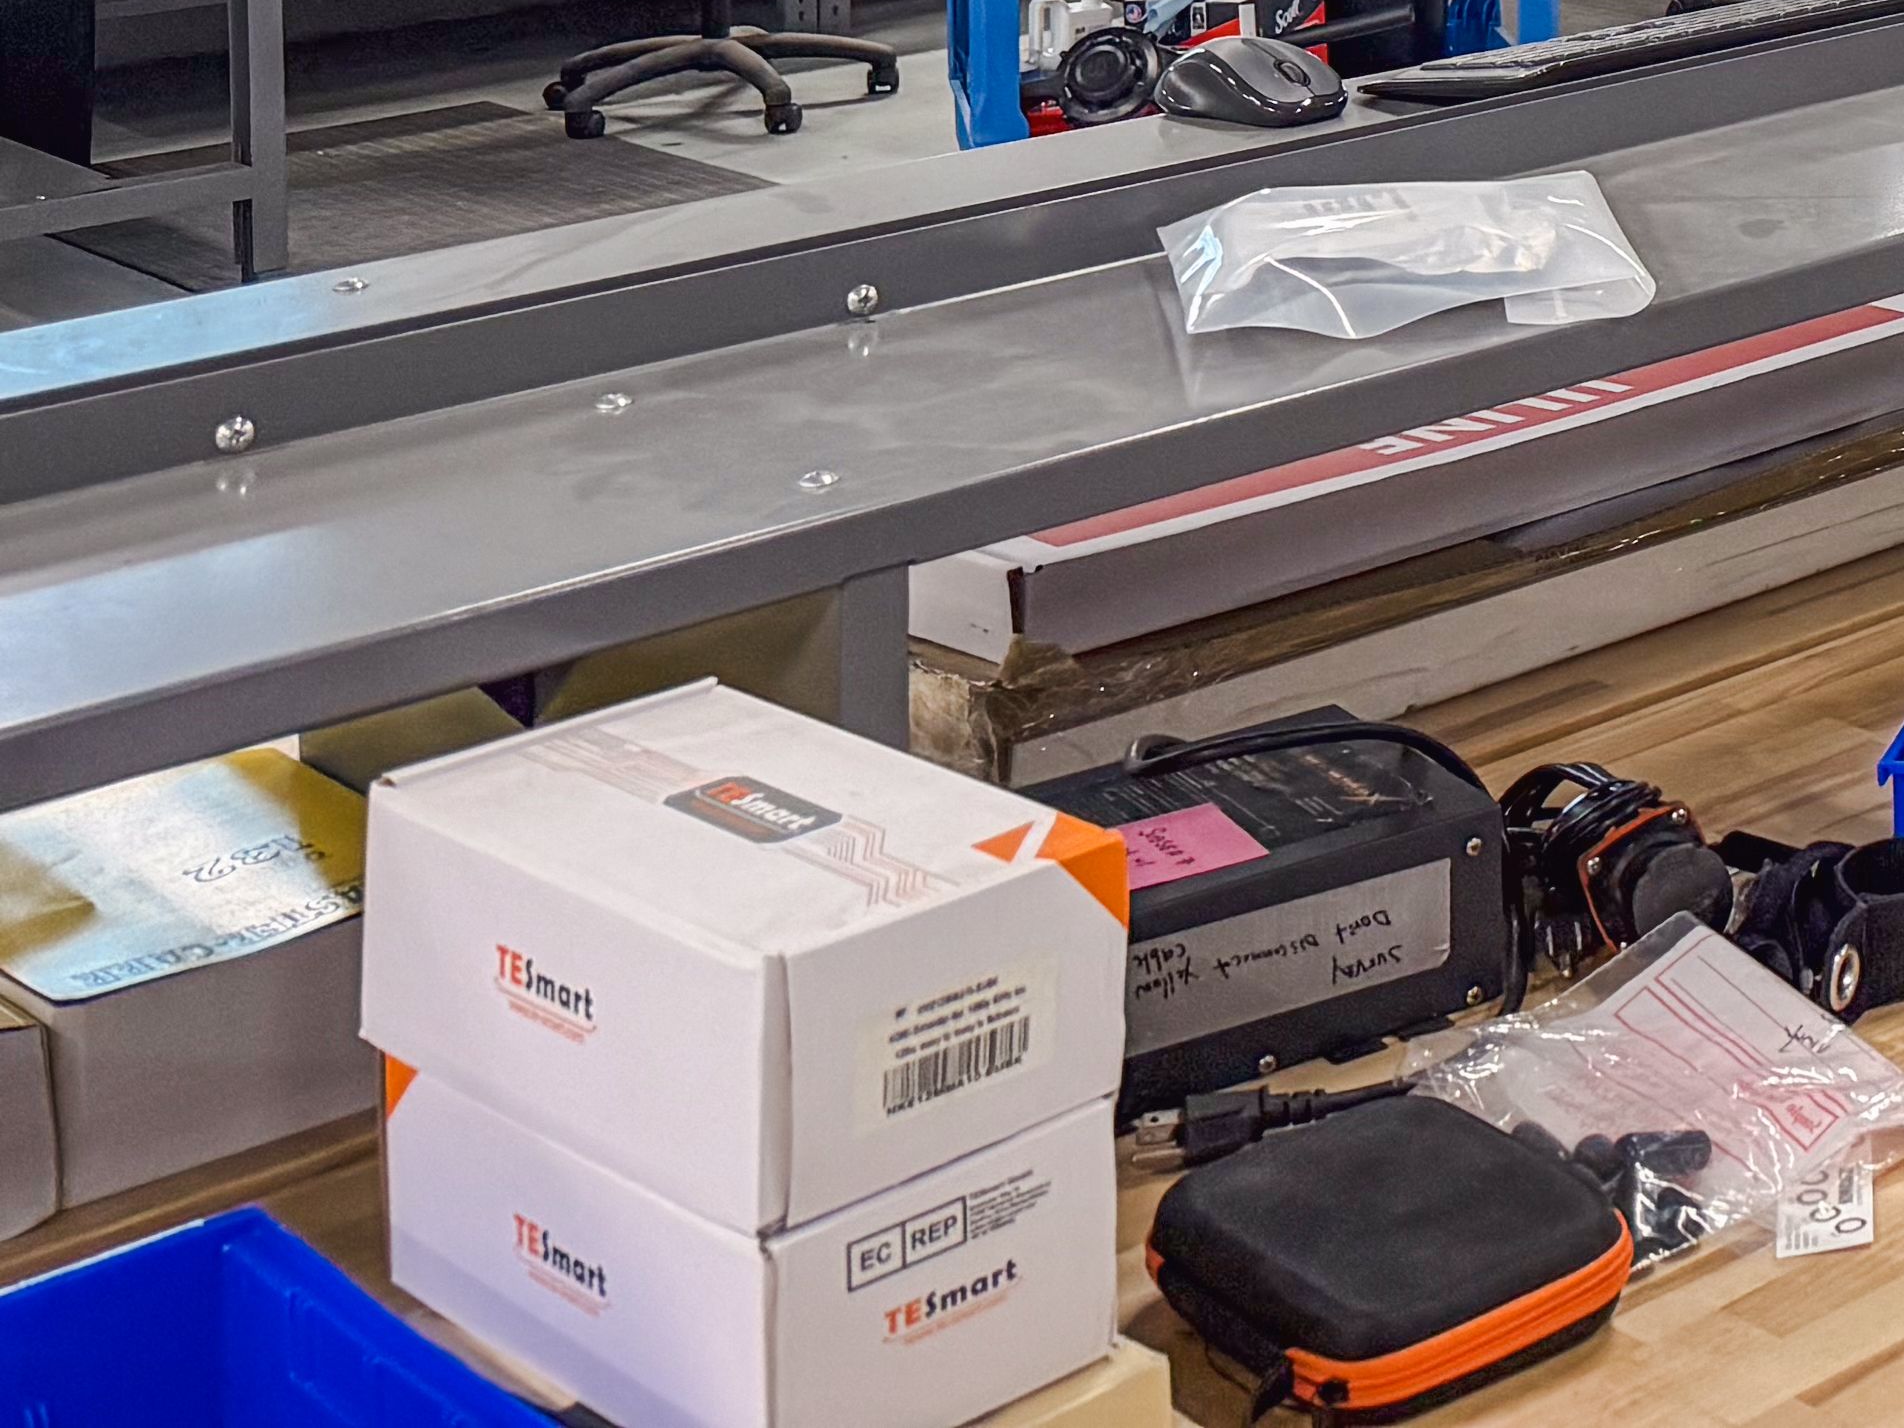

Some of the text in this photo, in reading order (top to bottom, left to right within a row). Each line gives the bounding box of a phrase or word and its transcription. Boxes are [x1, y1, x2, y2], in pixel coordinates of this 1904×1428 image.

[496, 943, 593, 1021] TESmart
[513, 1212, 607, 1297] TESmart
[860, 1214, 959, 1272] EC REP
[883, 1258, 1018, 1335] TESmart
